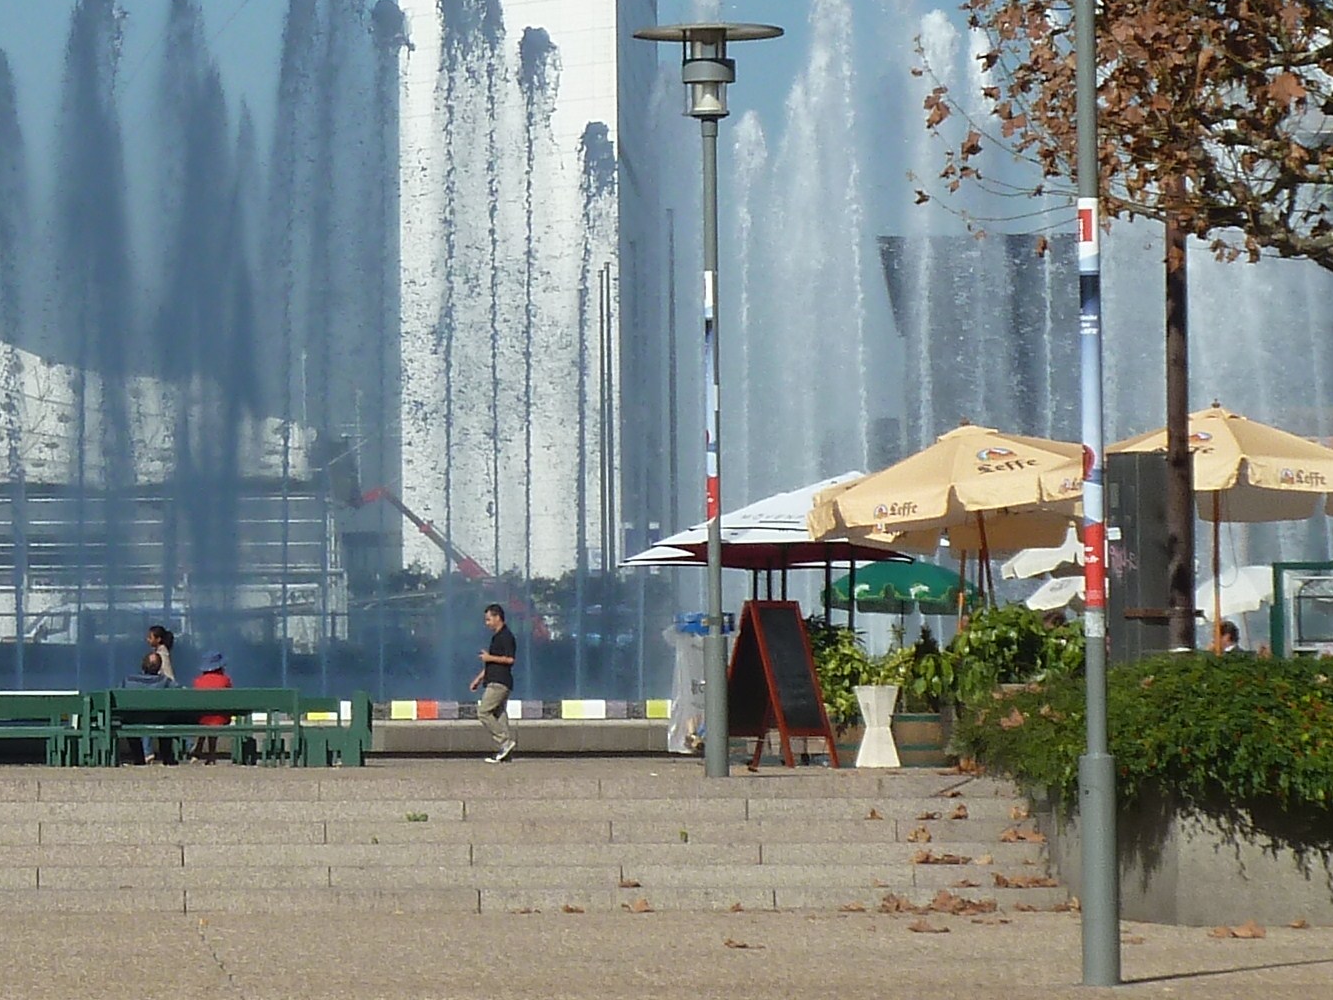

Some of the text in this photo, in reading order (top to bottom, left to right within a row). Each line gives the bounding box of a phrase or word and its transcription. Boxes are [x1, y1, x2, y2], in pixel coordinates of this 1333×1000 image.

[977, 458, 1040, 475] Leffe
[1296, 469, 1327, 487] Leffe
[889, 501, 918, 517] Leffe
